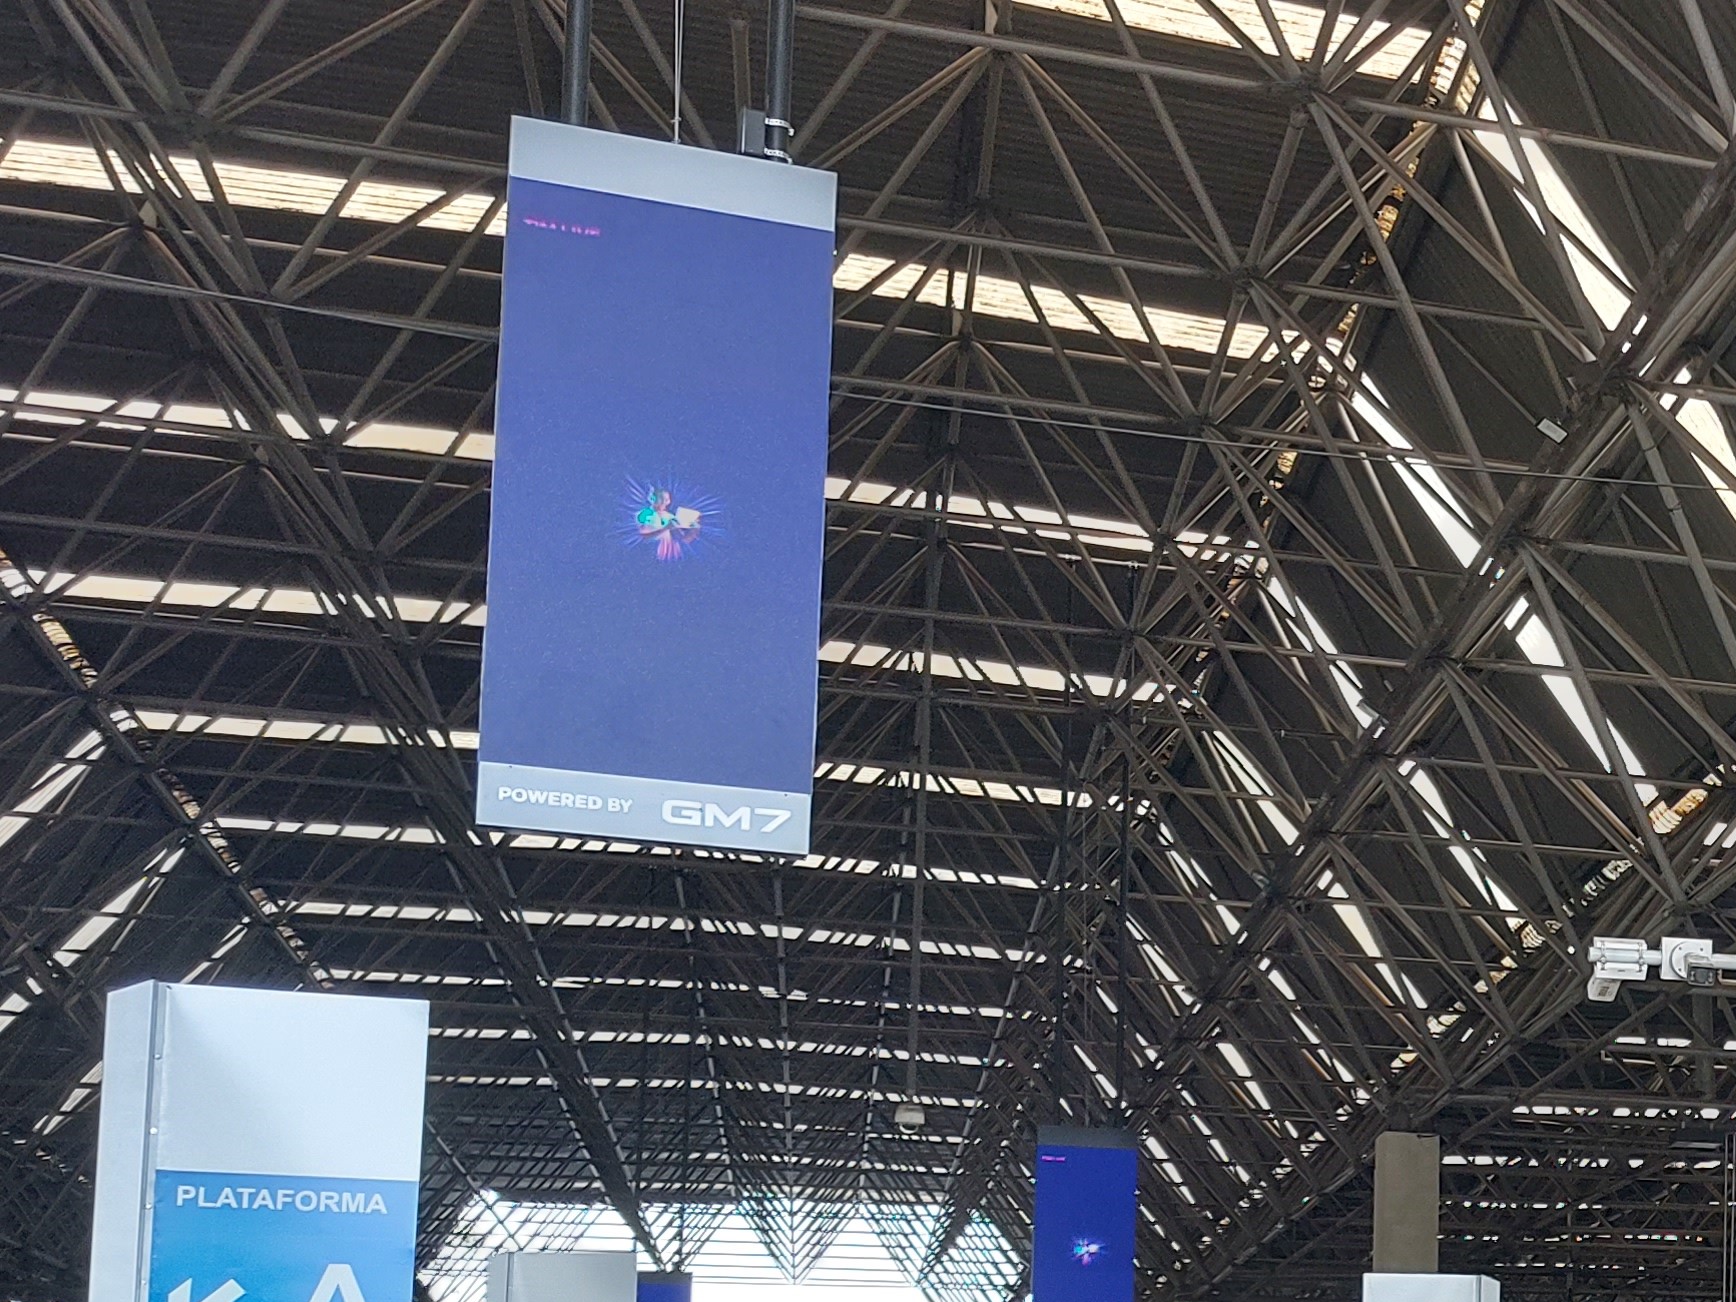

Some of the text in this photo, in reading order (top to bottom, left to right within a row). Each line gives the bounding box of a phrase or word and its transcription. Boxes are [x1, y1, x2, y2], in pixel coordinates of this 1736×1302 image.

[498, 786, 792, 833] POWERED BY GM7
[176, 1184, 388, 1215] PLATAFORMA
